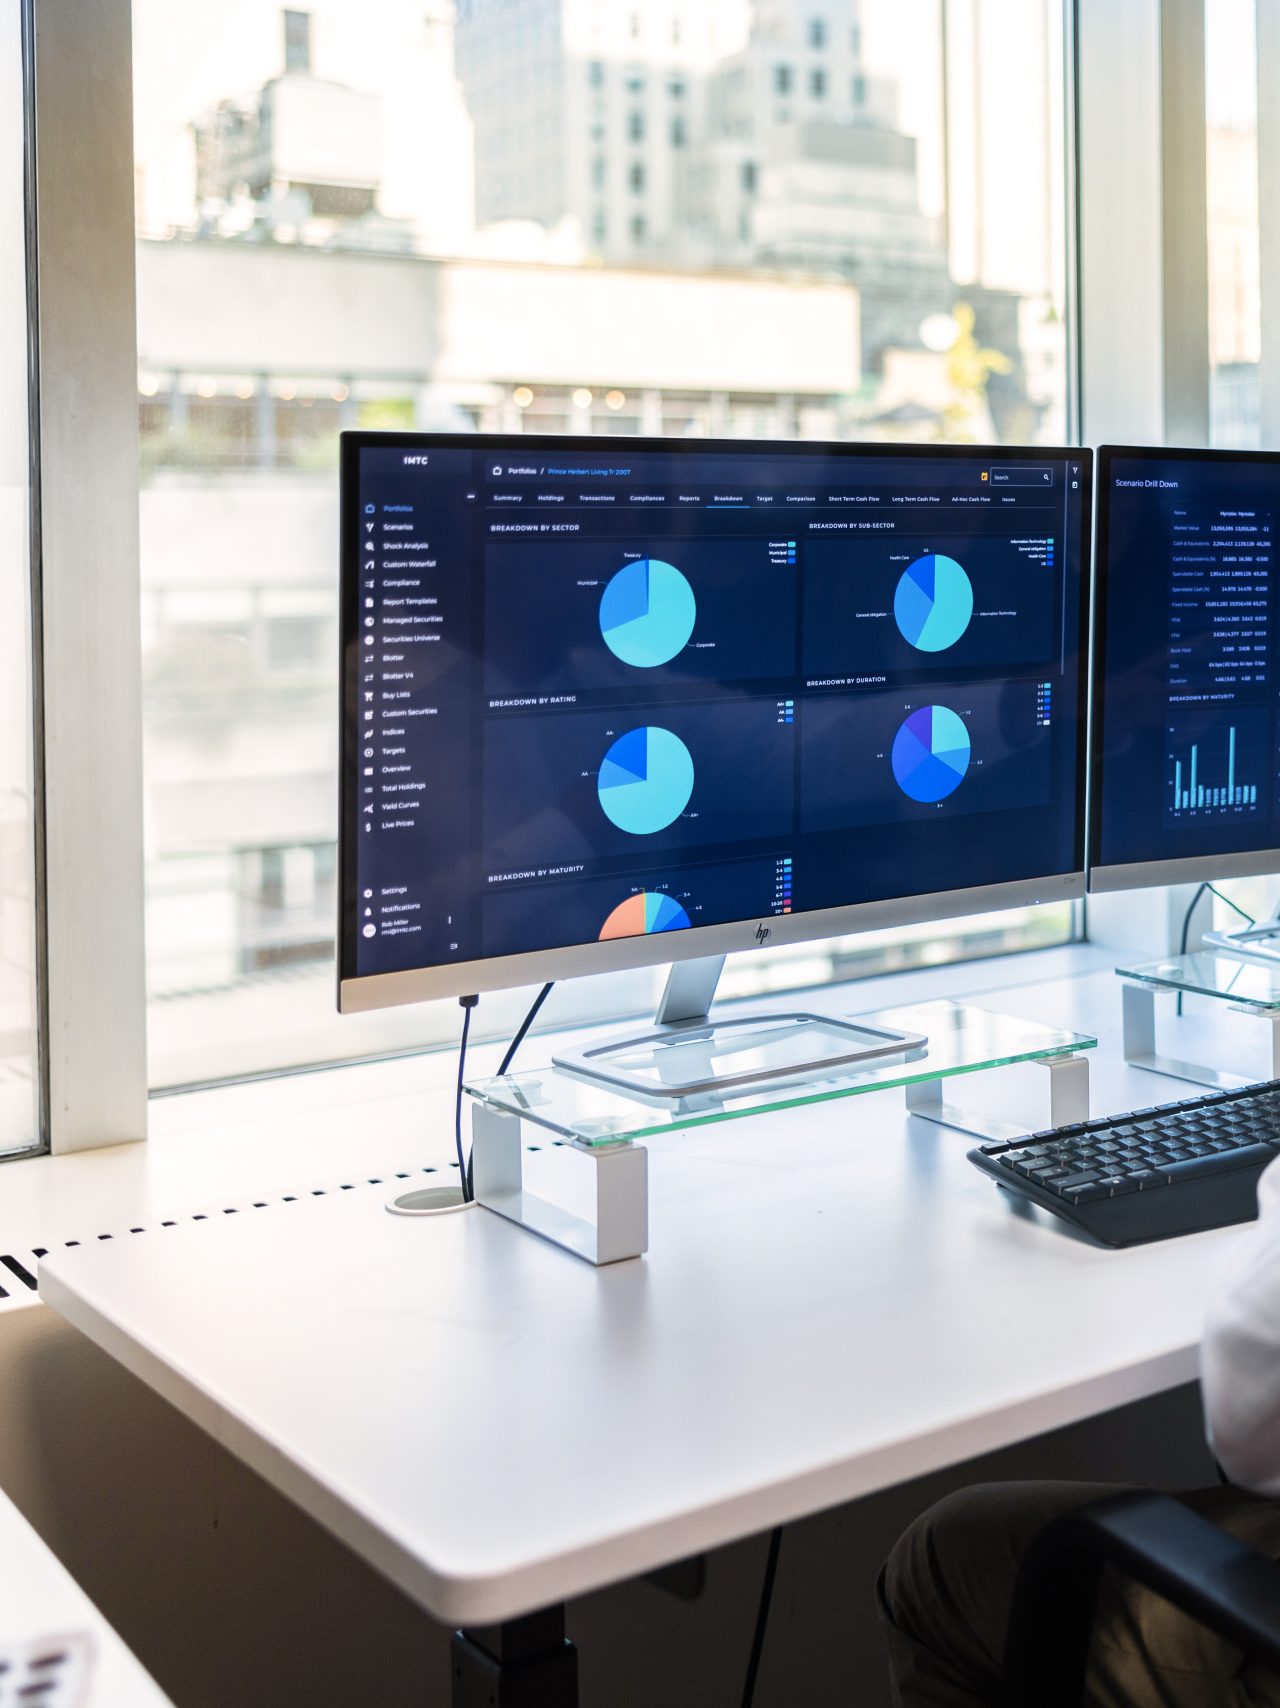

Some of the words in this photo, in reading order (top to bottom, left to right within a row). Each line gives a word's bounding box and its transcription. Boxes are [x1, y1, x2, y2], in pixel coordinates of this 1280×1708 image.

[403, 456, 429, 465] IMTC
[508, 467, 537, 475] Portfolios
[591, 468, 608, 476] Living
[1115, 479, 1144, 487] Scenario
[1159, 480, 1179, 488] Down
[383, 505, 413, 513] Portfolios
[383, 542, 403, 550] Shock
[404, 542, 429, 551] Analysis
[410, 560, 436, 568] Waterfall
[383, 579, 420, 588] Compliance
[383, 598, 404, 607] Report
[405, 597, 437, 606] Templates
[383, 616, 413, 625] Managed
[414, 615, 443, 623] Securities
[383, 635, 413, 643] Securities
[414, 634, 440, 642] Universe
[806, 679, 846, 687] BREAKDOWN
[856, 676, 886, 684] DURATION
[382, 692, 395, 700] Buy
[396, 691, 411, 699] Lists
[489, 700, 537, 708] BREAKDOWN
[550, 696, 576, 704] RATING
[408, 707, 438, 716] Securities
[382, 728, 405, 736] Indices
[382, 747, 406, 756] Targets
[382, 765, 411, 773] Overview
[382, 784, 397, 792] Total
[399, 782, 426, 791] Holdings
[382, 803, 397, 811] Yield
[399, 801, 419, 809] Curves
[396, 819, 414, 827] Prices
[488, 872, 536, 883] BREAKDOWN
[549, 865, 584, 875] MATURITY
[382, 886, 407, 896] Settings
[382, 902, 420, 913] Notifications
[755, 923, 769, 944] hp
